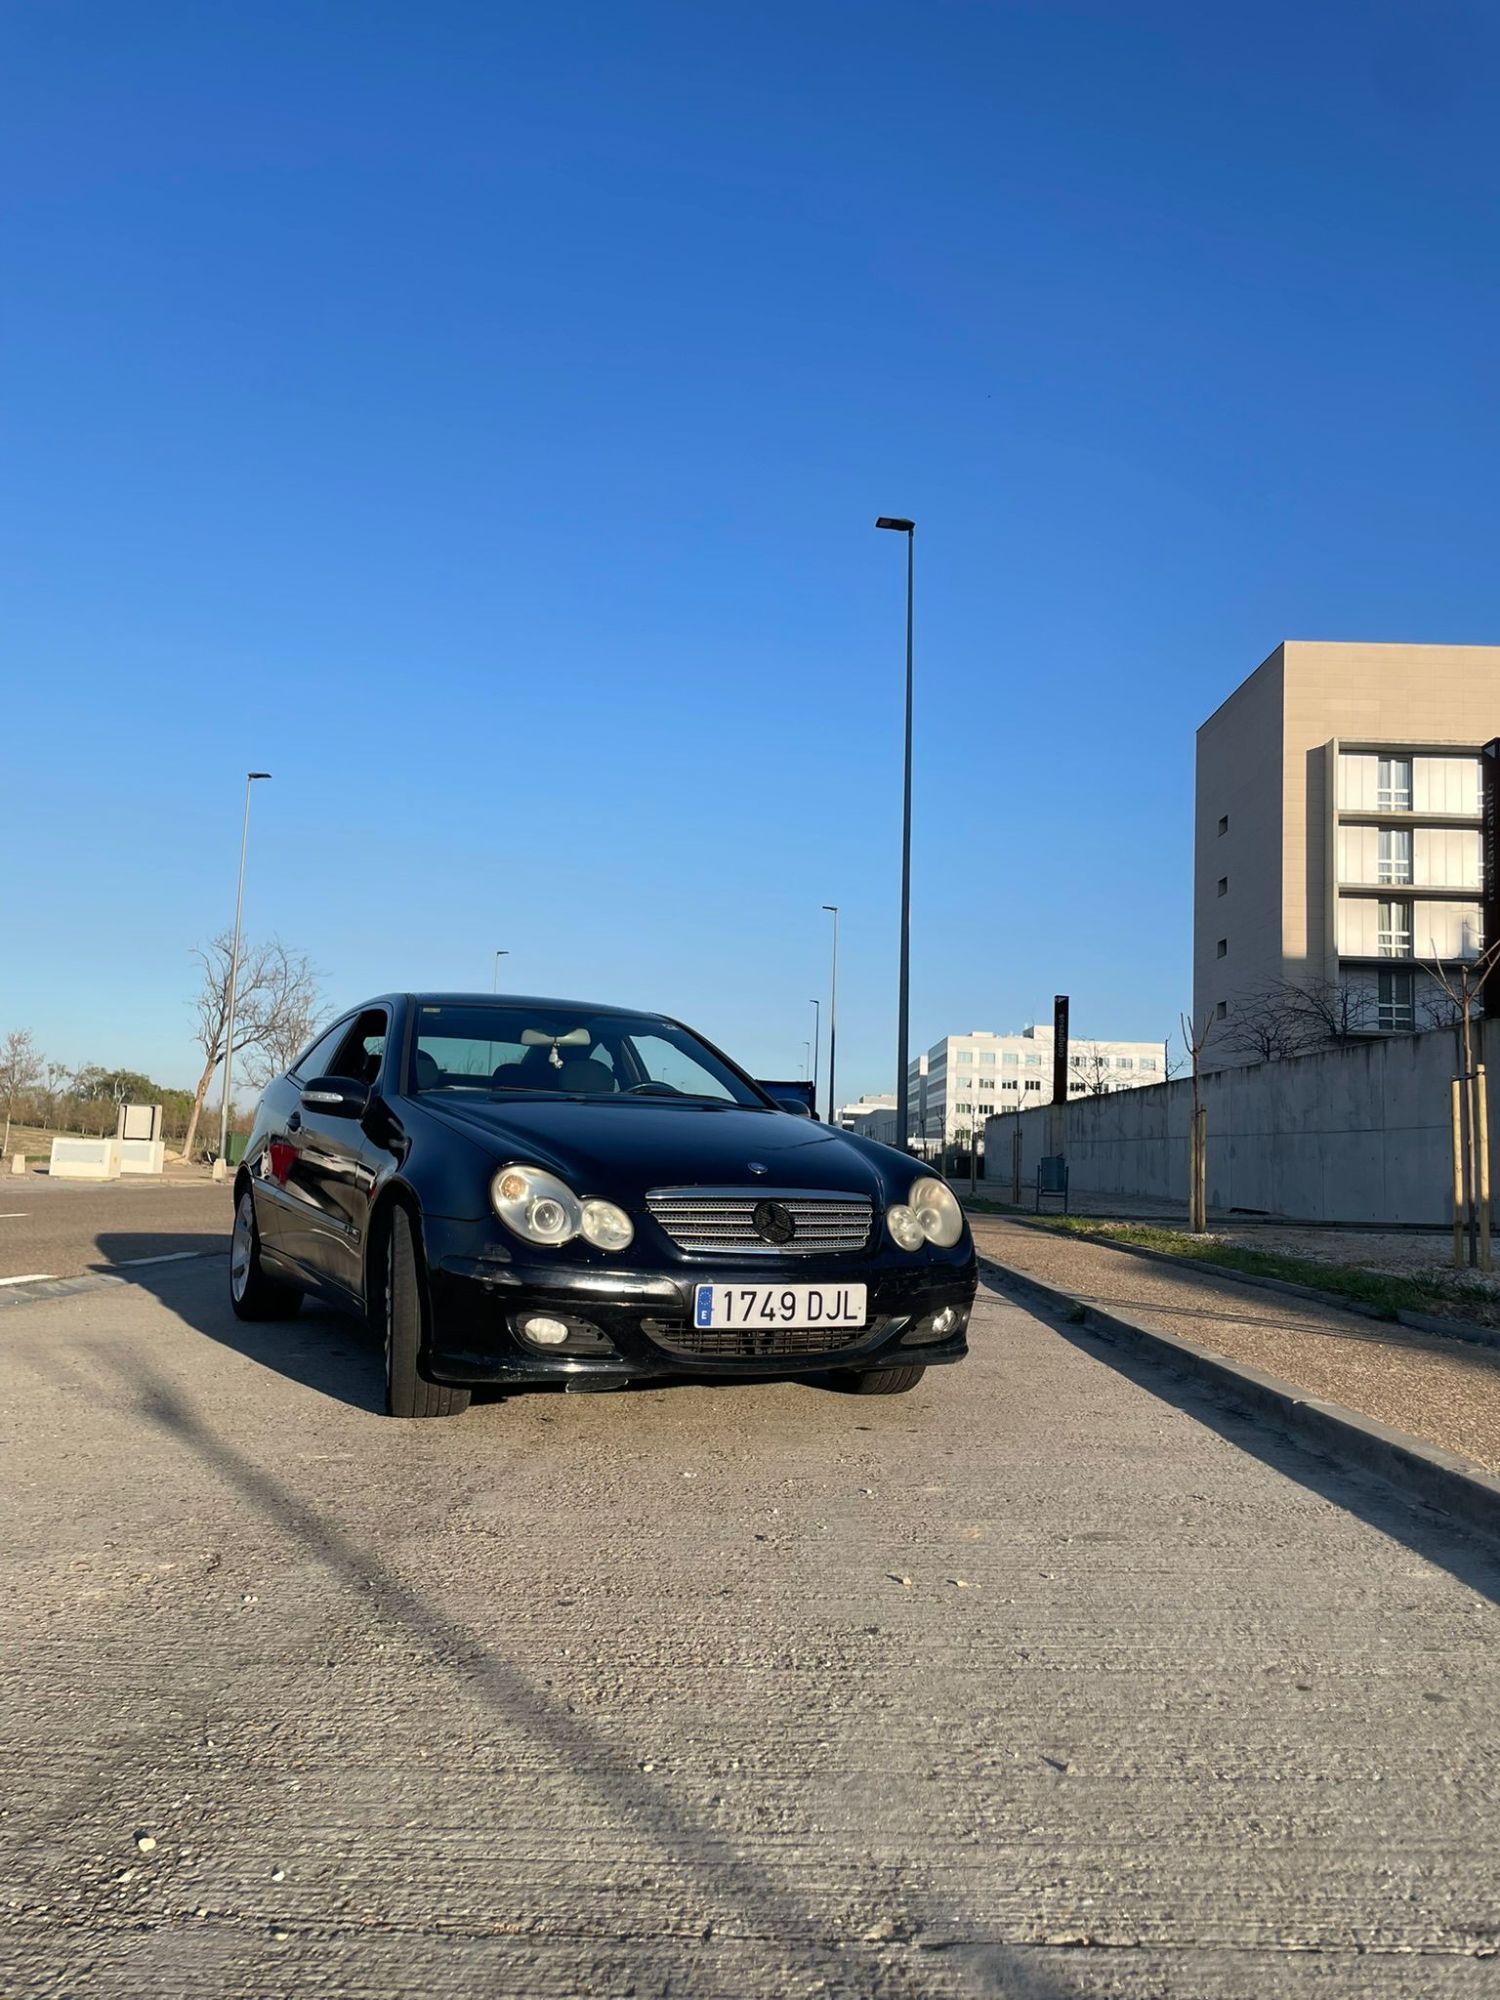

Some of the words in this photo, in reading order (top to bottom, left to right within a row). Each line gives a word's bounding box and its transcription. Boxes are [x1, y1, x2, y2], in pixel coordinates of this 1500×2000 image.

[701, 1310, 708, 1320] E
[724, 1290, 796, 1321] 1749
[807, 1290, 858, 1321] DJL
